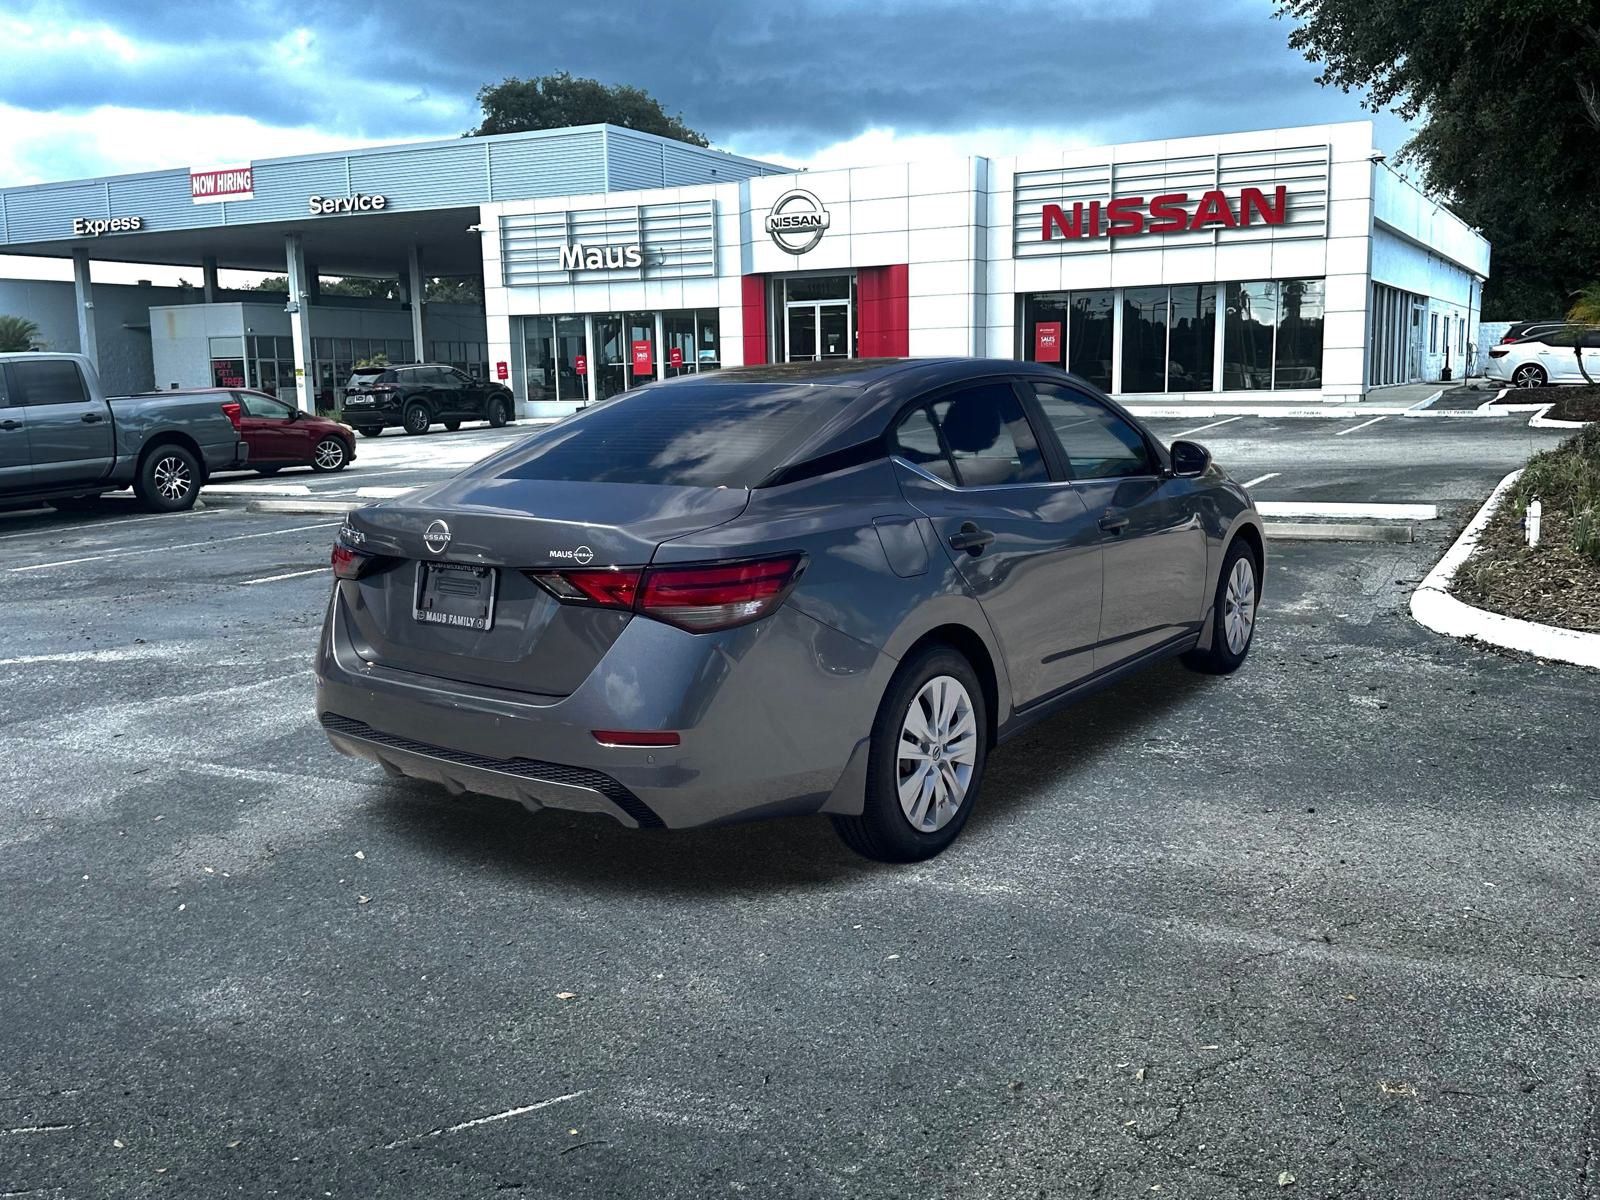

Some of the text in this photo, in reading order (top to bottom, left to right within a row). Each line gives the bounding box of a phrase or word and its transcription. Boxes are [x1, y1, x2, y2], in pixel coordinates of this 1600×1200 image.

[192, 170, 251, 195] NOW HIRING
[308, 192, 386, 215] Service
[1042, 185, 1287, 241] NISSAN
[73, 215, 141, 236] Express
[770, 214, 822, 228] NISSAN
[559, 243, 643, 271] Maus
[223, 377, 244, 386] FREE
[549, 550, 573, 558] MAUS
[426, 611, 476, 627] MAUS FAMILY
